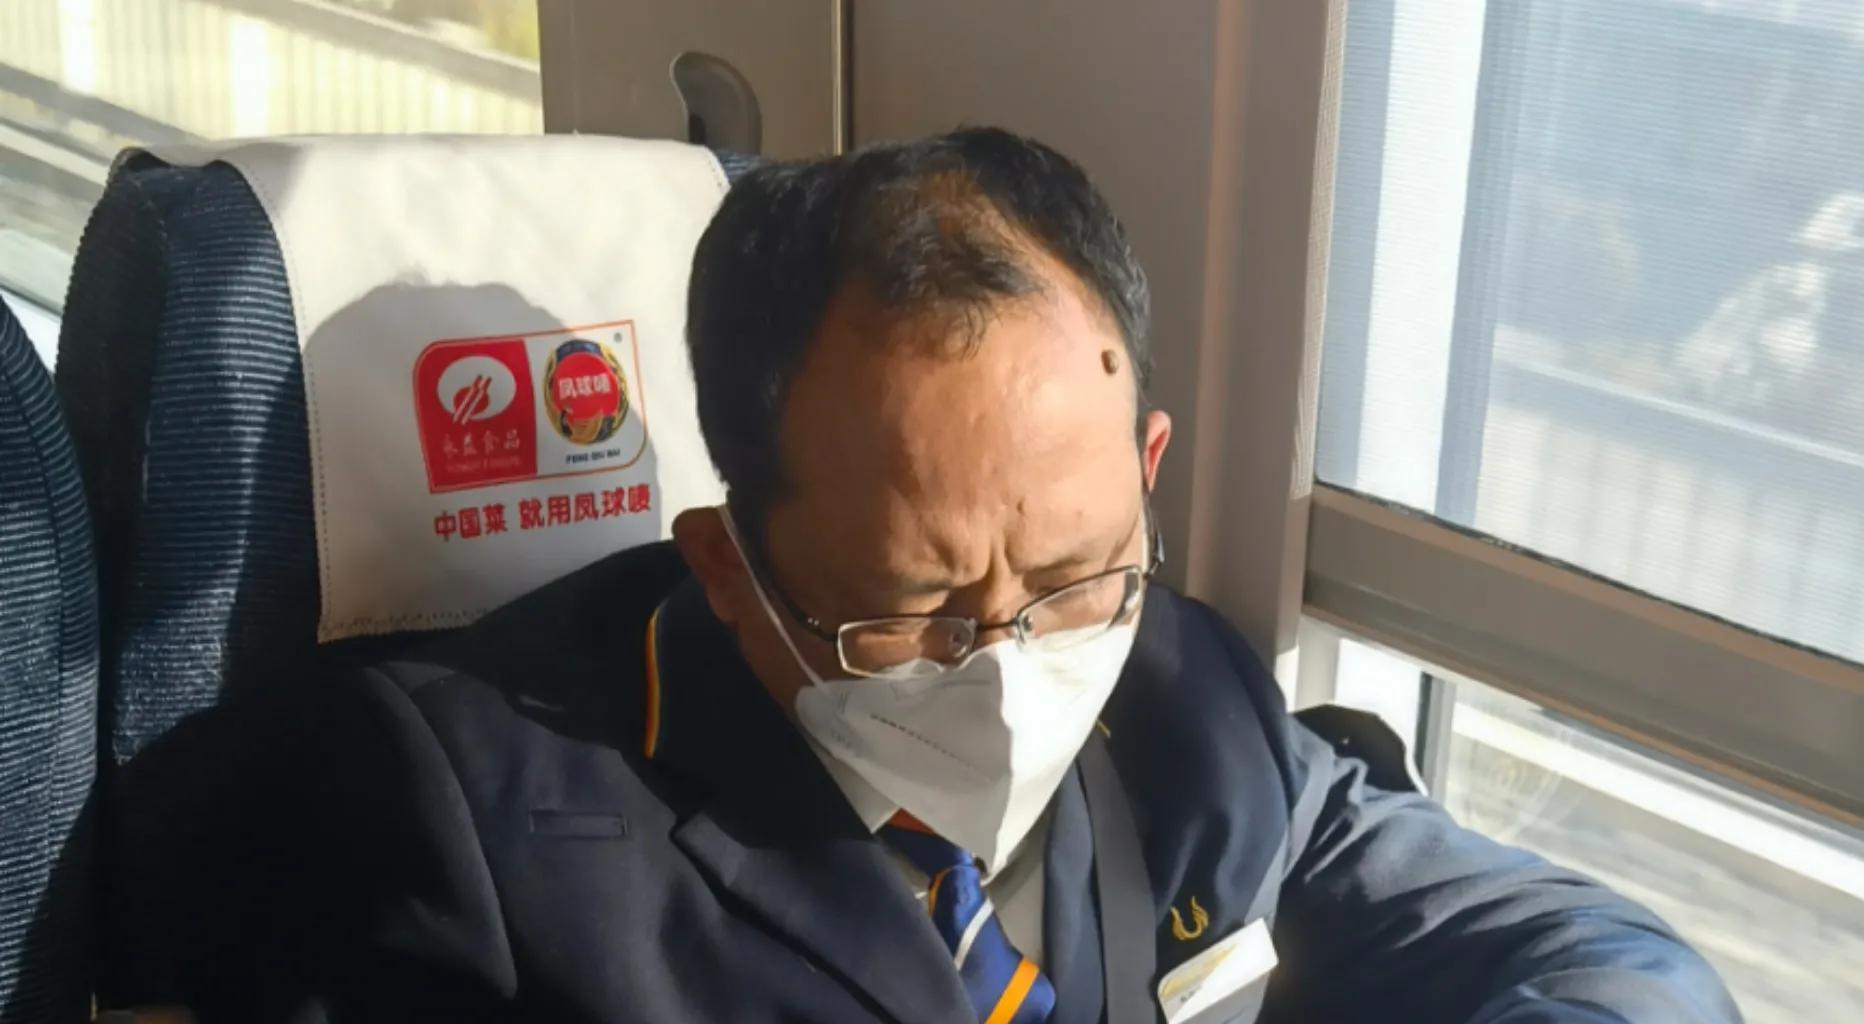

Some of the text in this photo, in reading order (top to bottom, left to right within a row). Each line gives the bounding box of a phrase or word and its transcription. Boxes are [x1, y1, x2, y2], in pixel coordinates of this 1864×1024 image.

[434, 484, 651, 542] 中国菜 就用凤球唛
